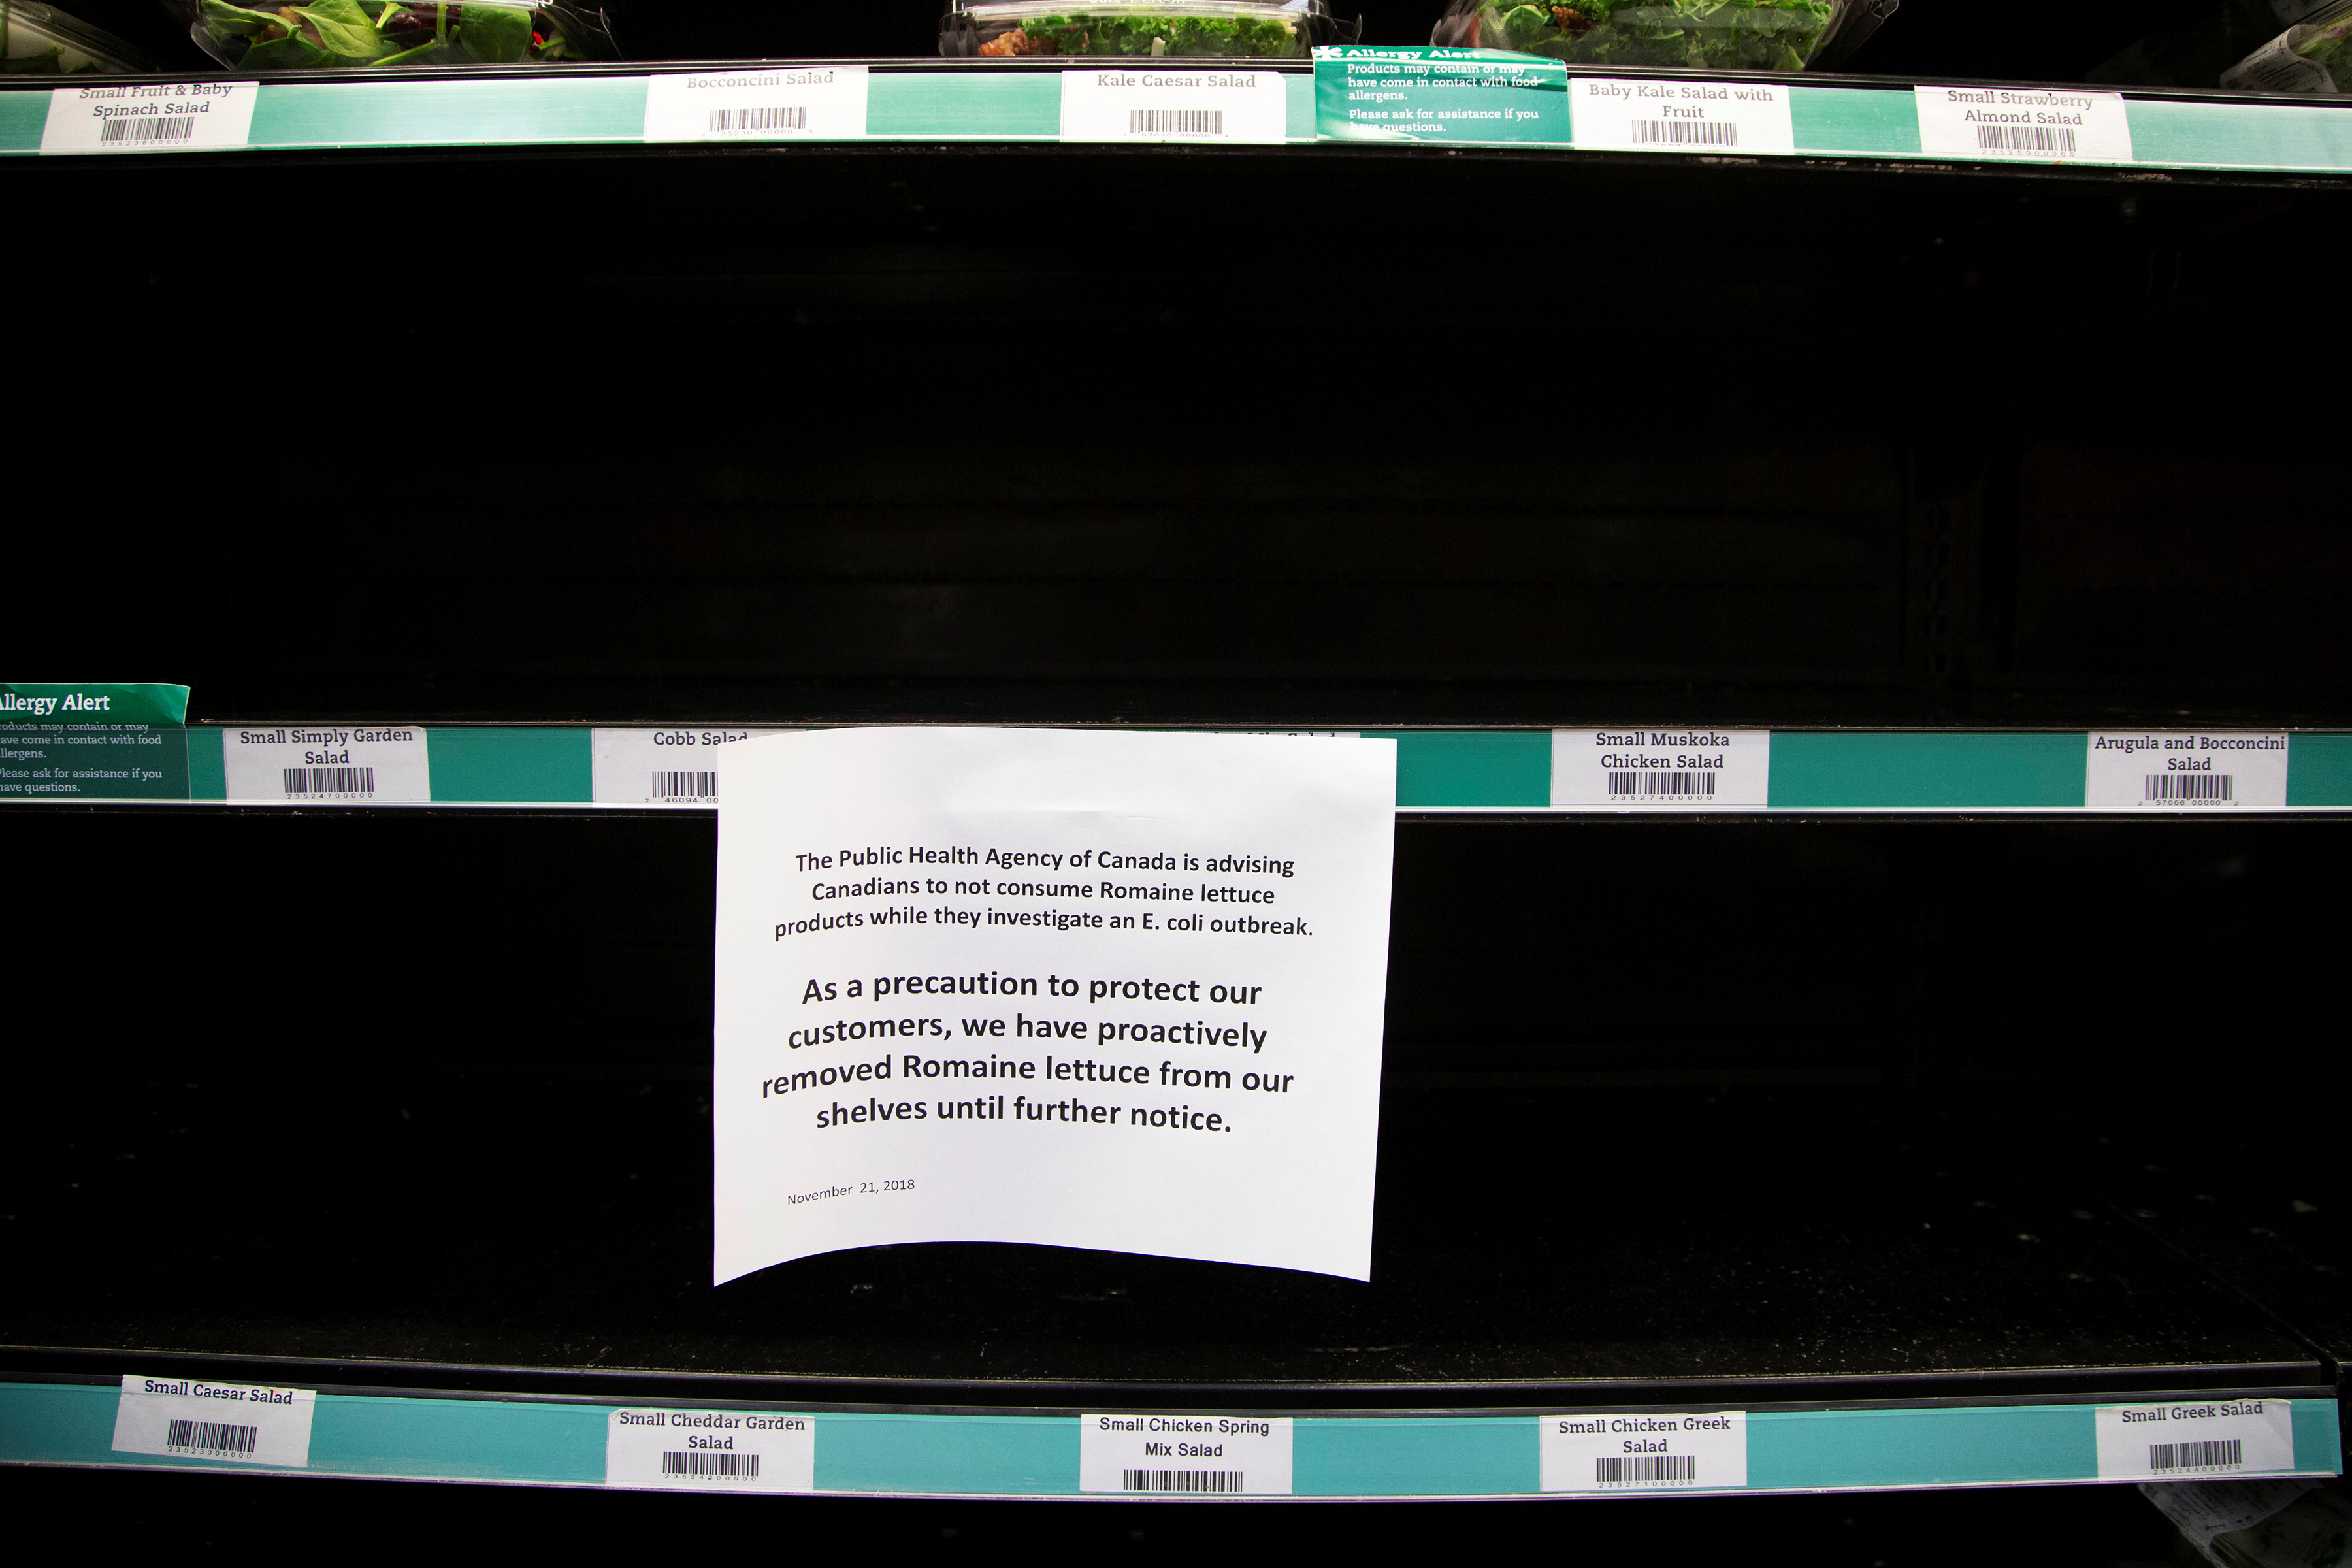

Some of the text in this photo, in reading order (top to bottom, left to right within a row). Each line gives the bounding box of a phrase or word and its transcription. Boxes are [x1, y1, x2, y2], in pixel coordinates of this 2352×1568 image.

[1347, 49, 1481, 59] Allergy Alert
[1348, 63, 1400, 74] Products
[1404, 65, 1430, 76] may
[1434, 65, 1480, 73] contain
[1499, 65, 1525, 76] may
[687, 71, 834, 89] Bocconcini Salad
[1098, 74, 1256, 88] Kale Caesar Salad
[1348, 77, 1377, 87] have
[1417, 77, 1429, 87] in
[1432, 78, 1477, 87] contact
[1480, 77, 1508, 87] with
[1511, 77, 1538, 86] food
[80, 84, 233, 99] Small Fruit & Baby
[1348, 91, 1408, 103] allergens.
[1589, 84, 1773, 101] Baby Kale Salad with
[1948, 90, 2093, 110] Small Strawberry
[93, 101, 210, 120] Spinach Salad
[1349, 109, 1539, 121] Please ask for assistance if you
[1663, 105, 1705, 118] Fruit
[1965, 110, 2083, 125] Almond Salad
[1350, 122, 1379, 131] have
[0, 694, 110, 715] llergy Alert
[40, 724, 63, 733] may
[67, 722, 108, 731] contain
[125, 724, 148, 733] may
[54, 735, 65, 744] in
[67, 736, 107, 744] contact
[110, 734, 135, 744] with
[137, 734, 162, 744] food
[240, 728, 413, 747] Small Simply Garden
[653, 732, 696, 745] Cobb
[1596, 732, 1730, 747] Small Muskoka
[2095, 736, 2285, 753] Arugula and Bocconcini
[305, 750, 350, 764] Salad
[1601, 754, 1723, 768] Chicken Salad
[2168, 757, 2212, 771] Salad
[33, 768, 162, 781] ask for assistance if you
[25, 782, 80, 794] questions.
[795, 845, 1295, 878] The Public Health Agency of Canada is advising
[812, 877, 1275, 904] Canadians to not consume Romaine lettuce
[776, 906, 1313, 942] products while they investigate an E. coli outbreak.
[802, 970, 1262, 1005] As a precaution to protect our
[789, 1013, 1267, 1054] customers, we have proactively
[762, 1054, 1294, 1099] removed Romaine lettuce from our
[817, 1095, 1231, 1132] shelves until further notice.
[788, 1179, 915, 1206] November 21, 2018
[144, 1380, 293, 1405] Small Caesar Salad
[2122, 1401, 2263, 1423] Small Greek Salad
[620, 1412, 806, 1431] Small Cheddar Garden
[1100, 1417, 1269, 1436] Small Chicken Spring
[1560, 1416, 1731, 1433] Small Chicken Greek
[688, 1435, 734, 1450] Salad
[1145, 1443, 1222, 1456] Mix Salad
[1623, 1439, 1668, 1453] Salad
[168, 1446, 252, 1459] 23523300000
[2153, 1464, 2240, 1475] 23524400000
[1599, 1480, 1693, 1488] 23527100000
